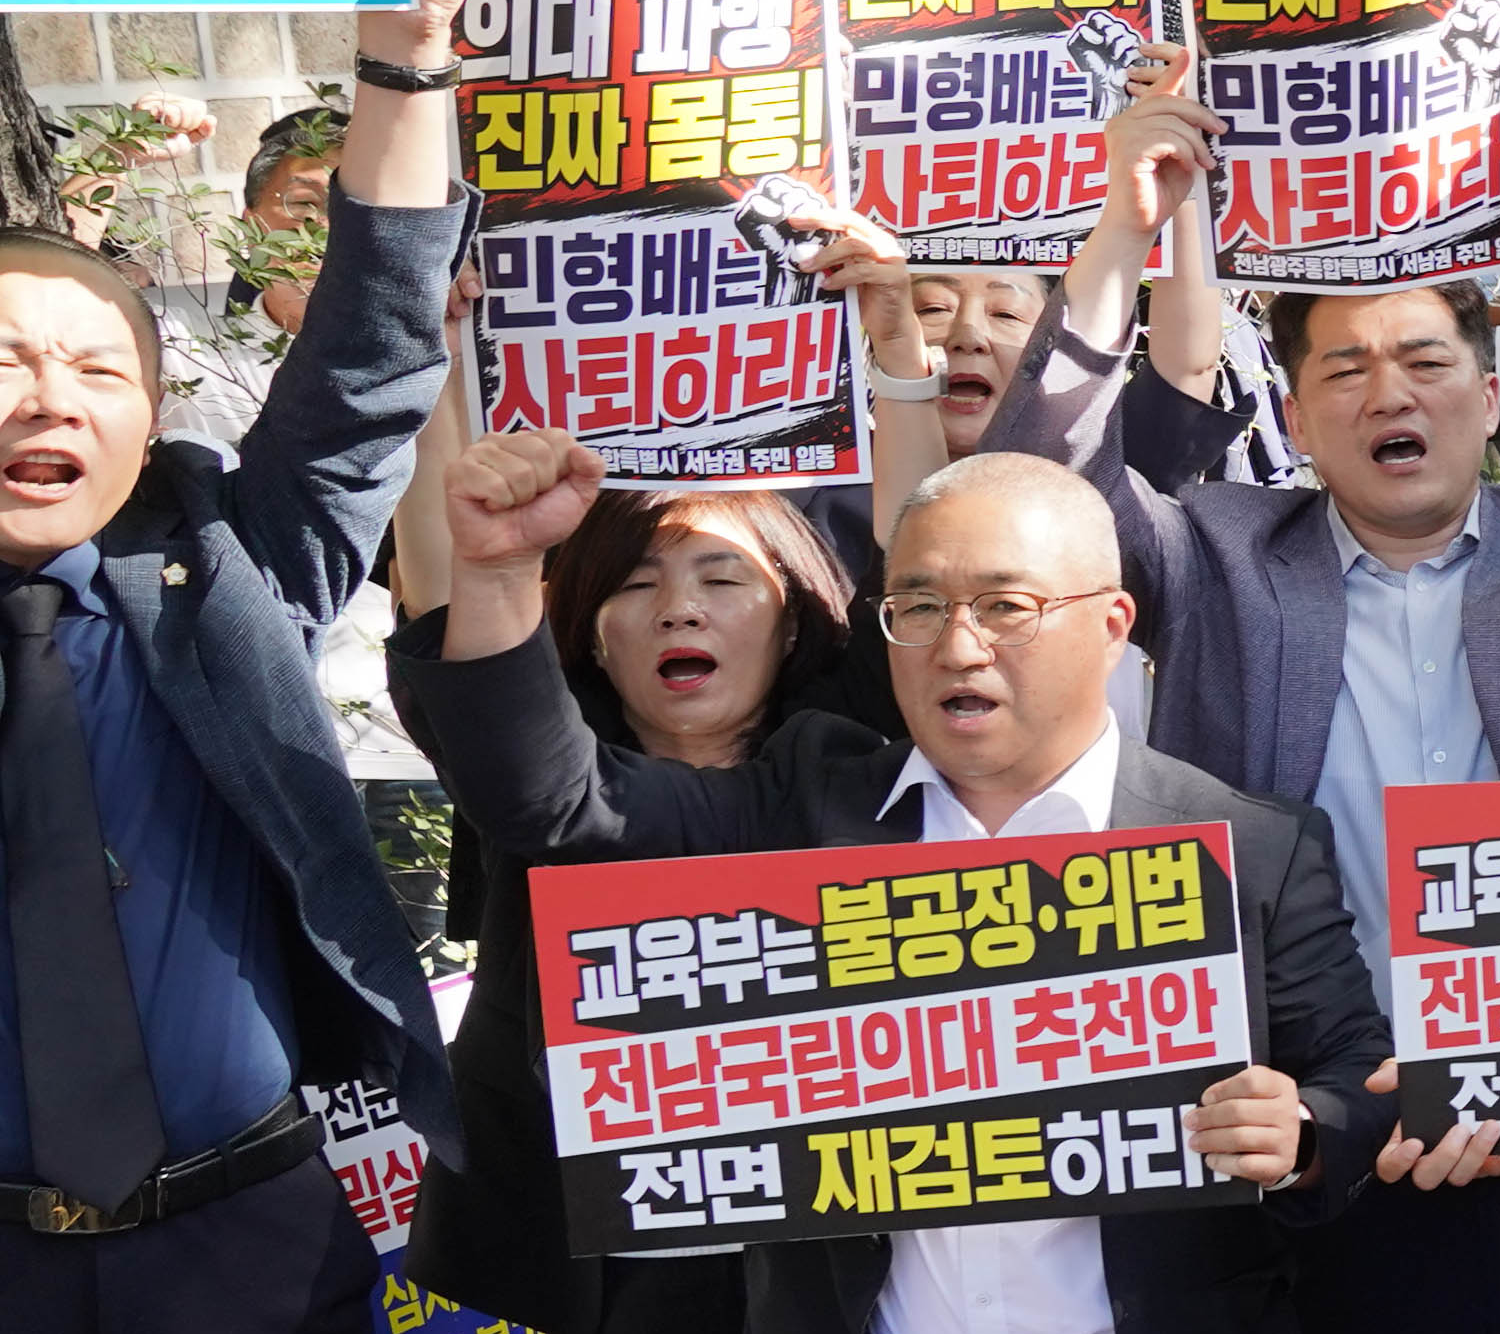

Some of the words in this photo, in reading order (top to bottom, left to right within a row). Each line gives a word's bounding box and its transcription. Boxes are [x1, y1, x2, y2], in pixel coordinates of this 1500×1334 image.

[474, 89, 628, 191] 진짜
[647, 69, 825, 183] 몸통!
[853, 50, 1092, 136] 민형배는
[1207, 53, 1458, 146] 민형배는
[481, 228, 761, 328] 민형배는
[1233, 251, 1395, 280] 전남광주통합특별시
[1398, 247, 1451, 275] 서남권
[1454, 242, 1490, 266] 주민
[491, 306, 838, 433] 사퇴하라!
[682, 447, 745, 475] 서남권
[750, 446, 791, 473] 주민
[796, 445, 836, 471] 일동
[571, 911, 818, 1021] 교육부는
[579, 996, 1000, 1143] 전남국립의대
[1014, 967, 1217, 1081] 추천안
[620, 1142, 786, 1232] 전면
